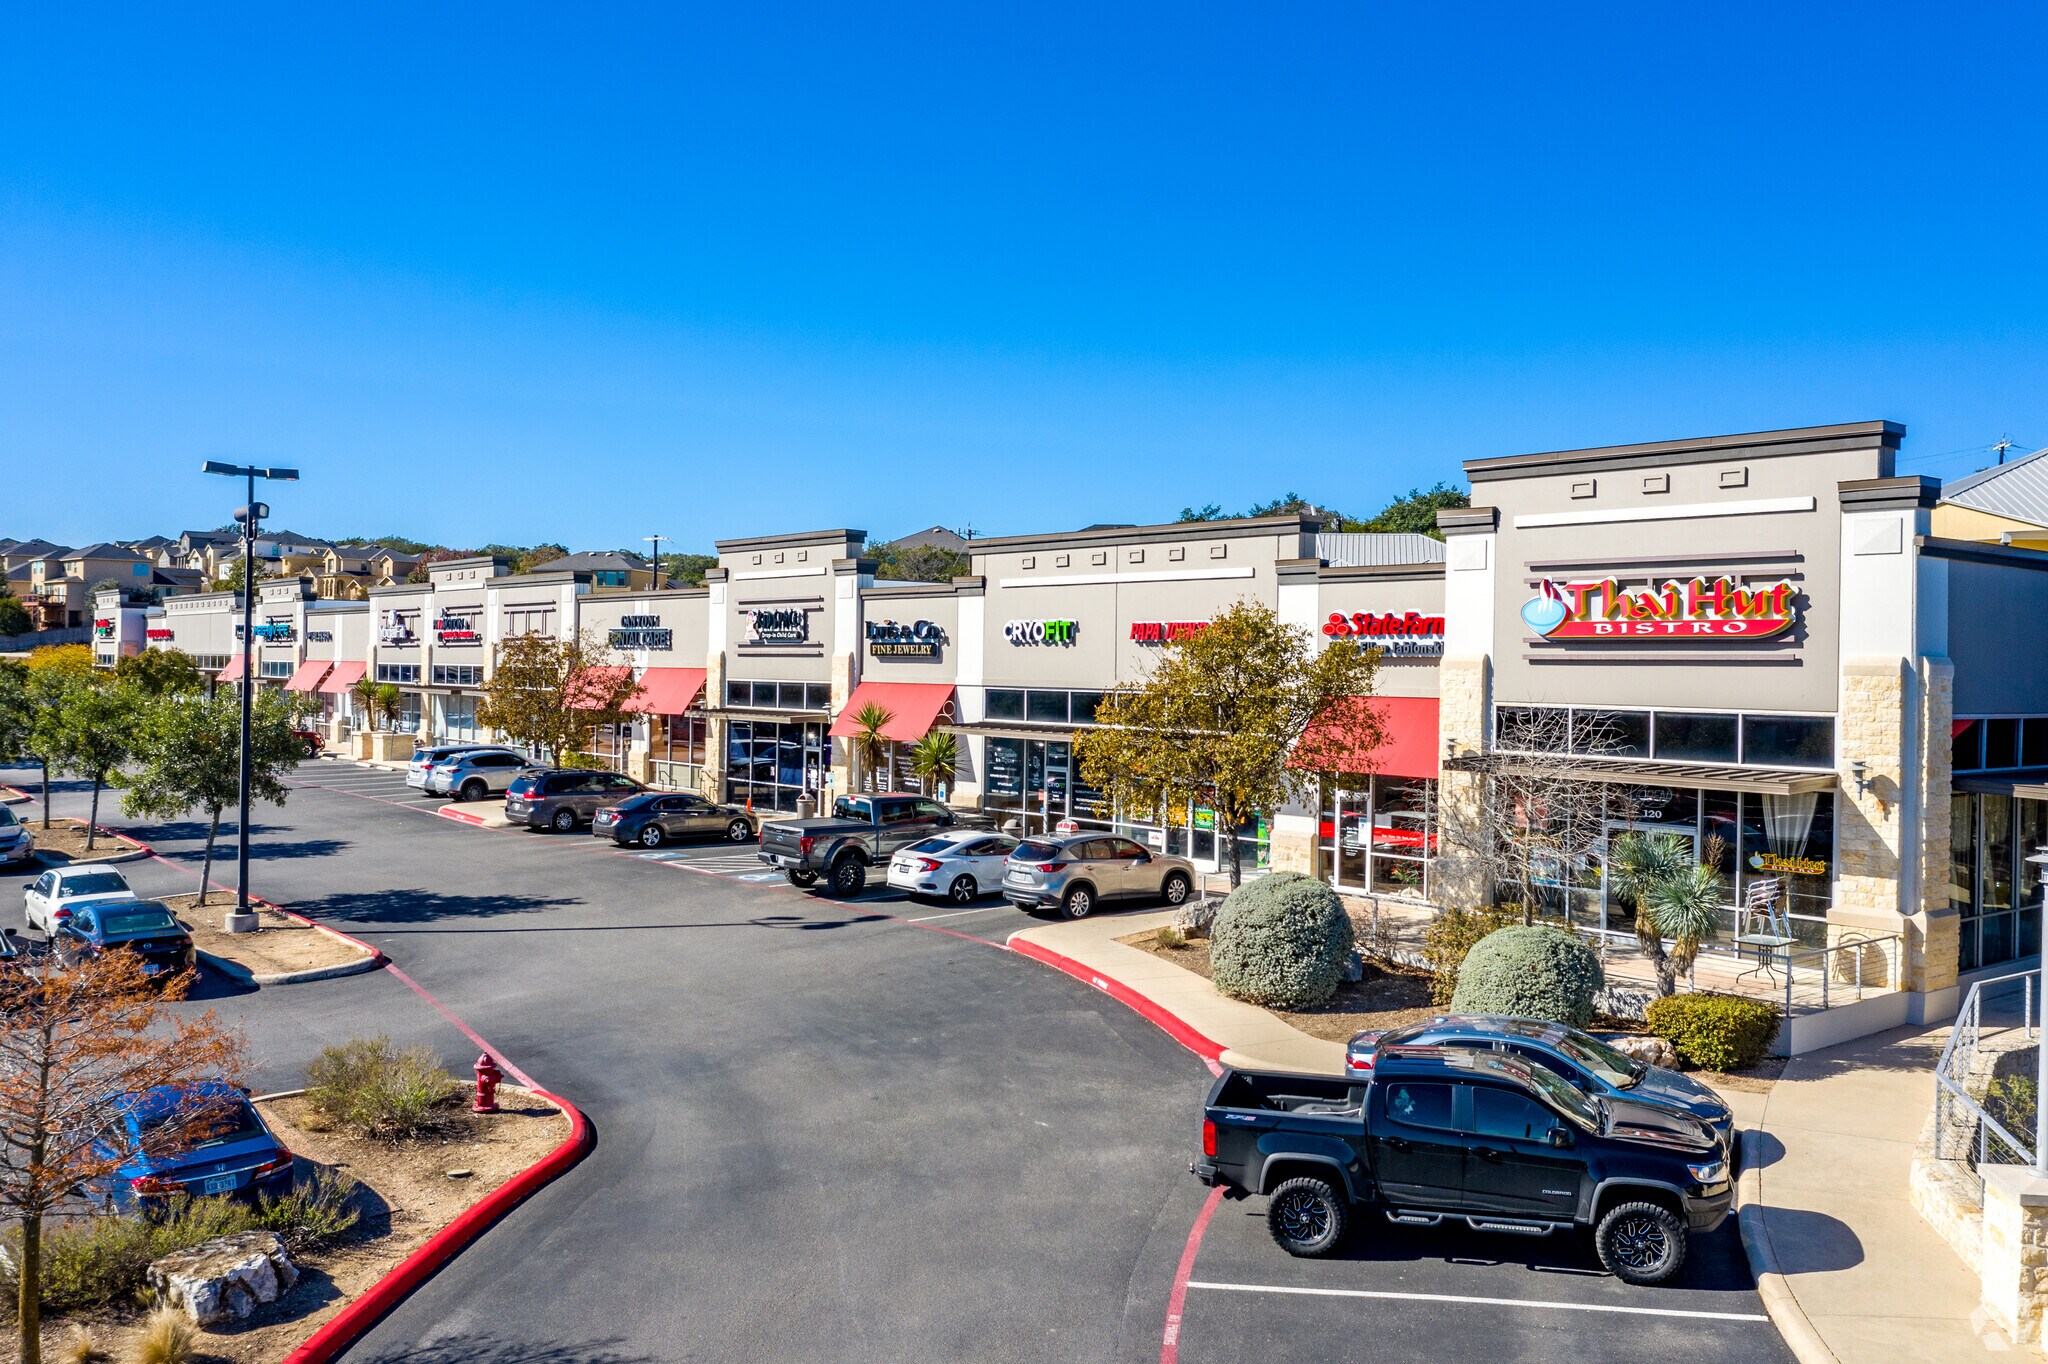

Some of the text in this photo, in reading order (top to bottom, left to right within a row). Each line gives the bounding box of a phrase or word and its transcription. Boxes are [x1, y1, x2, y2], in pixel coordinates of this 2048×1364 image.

[1561, 577, 1795, 620] Thai Hut
[1003, 620, 1071, 642] CRYOFIT
[1129, 622, 1163, 640] PAPA
[1351, 612, 1400, 635] State
[1594, 621, 1748, 636] BISTRO
[872, 644, 932, 654] FINE JEWELRY
[1392, 642, 1444, 654] Jablonski
[1643, 809, 1662, 819] 120
[1761, 853, 1826, 870] Thai Hut
